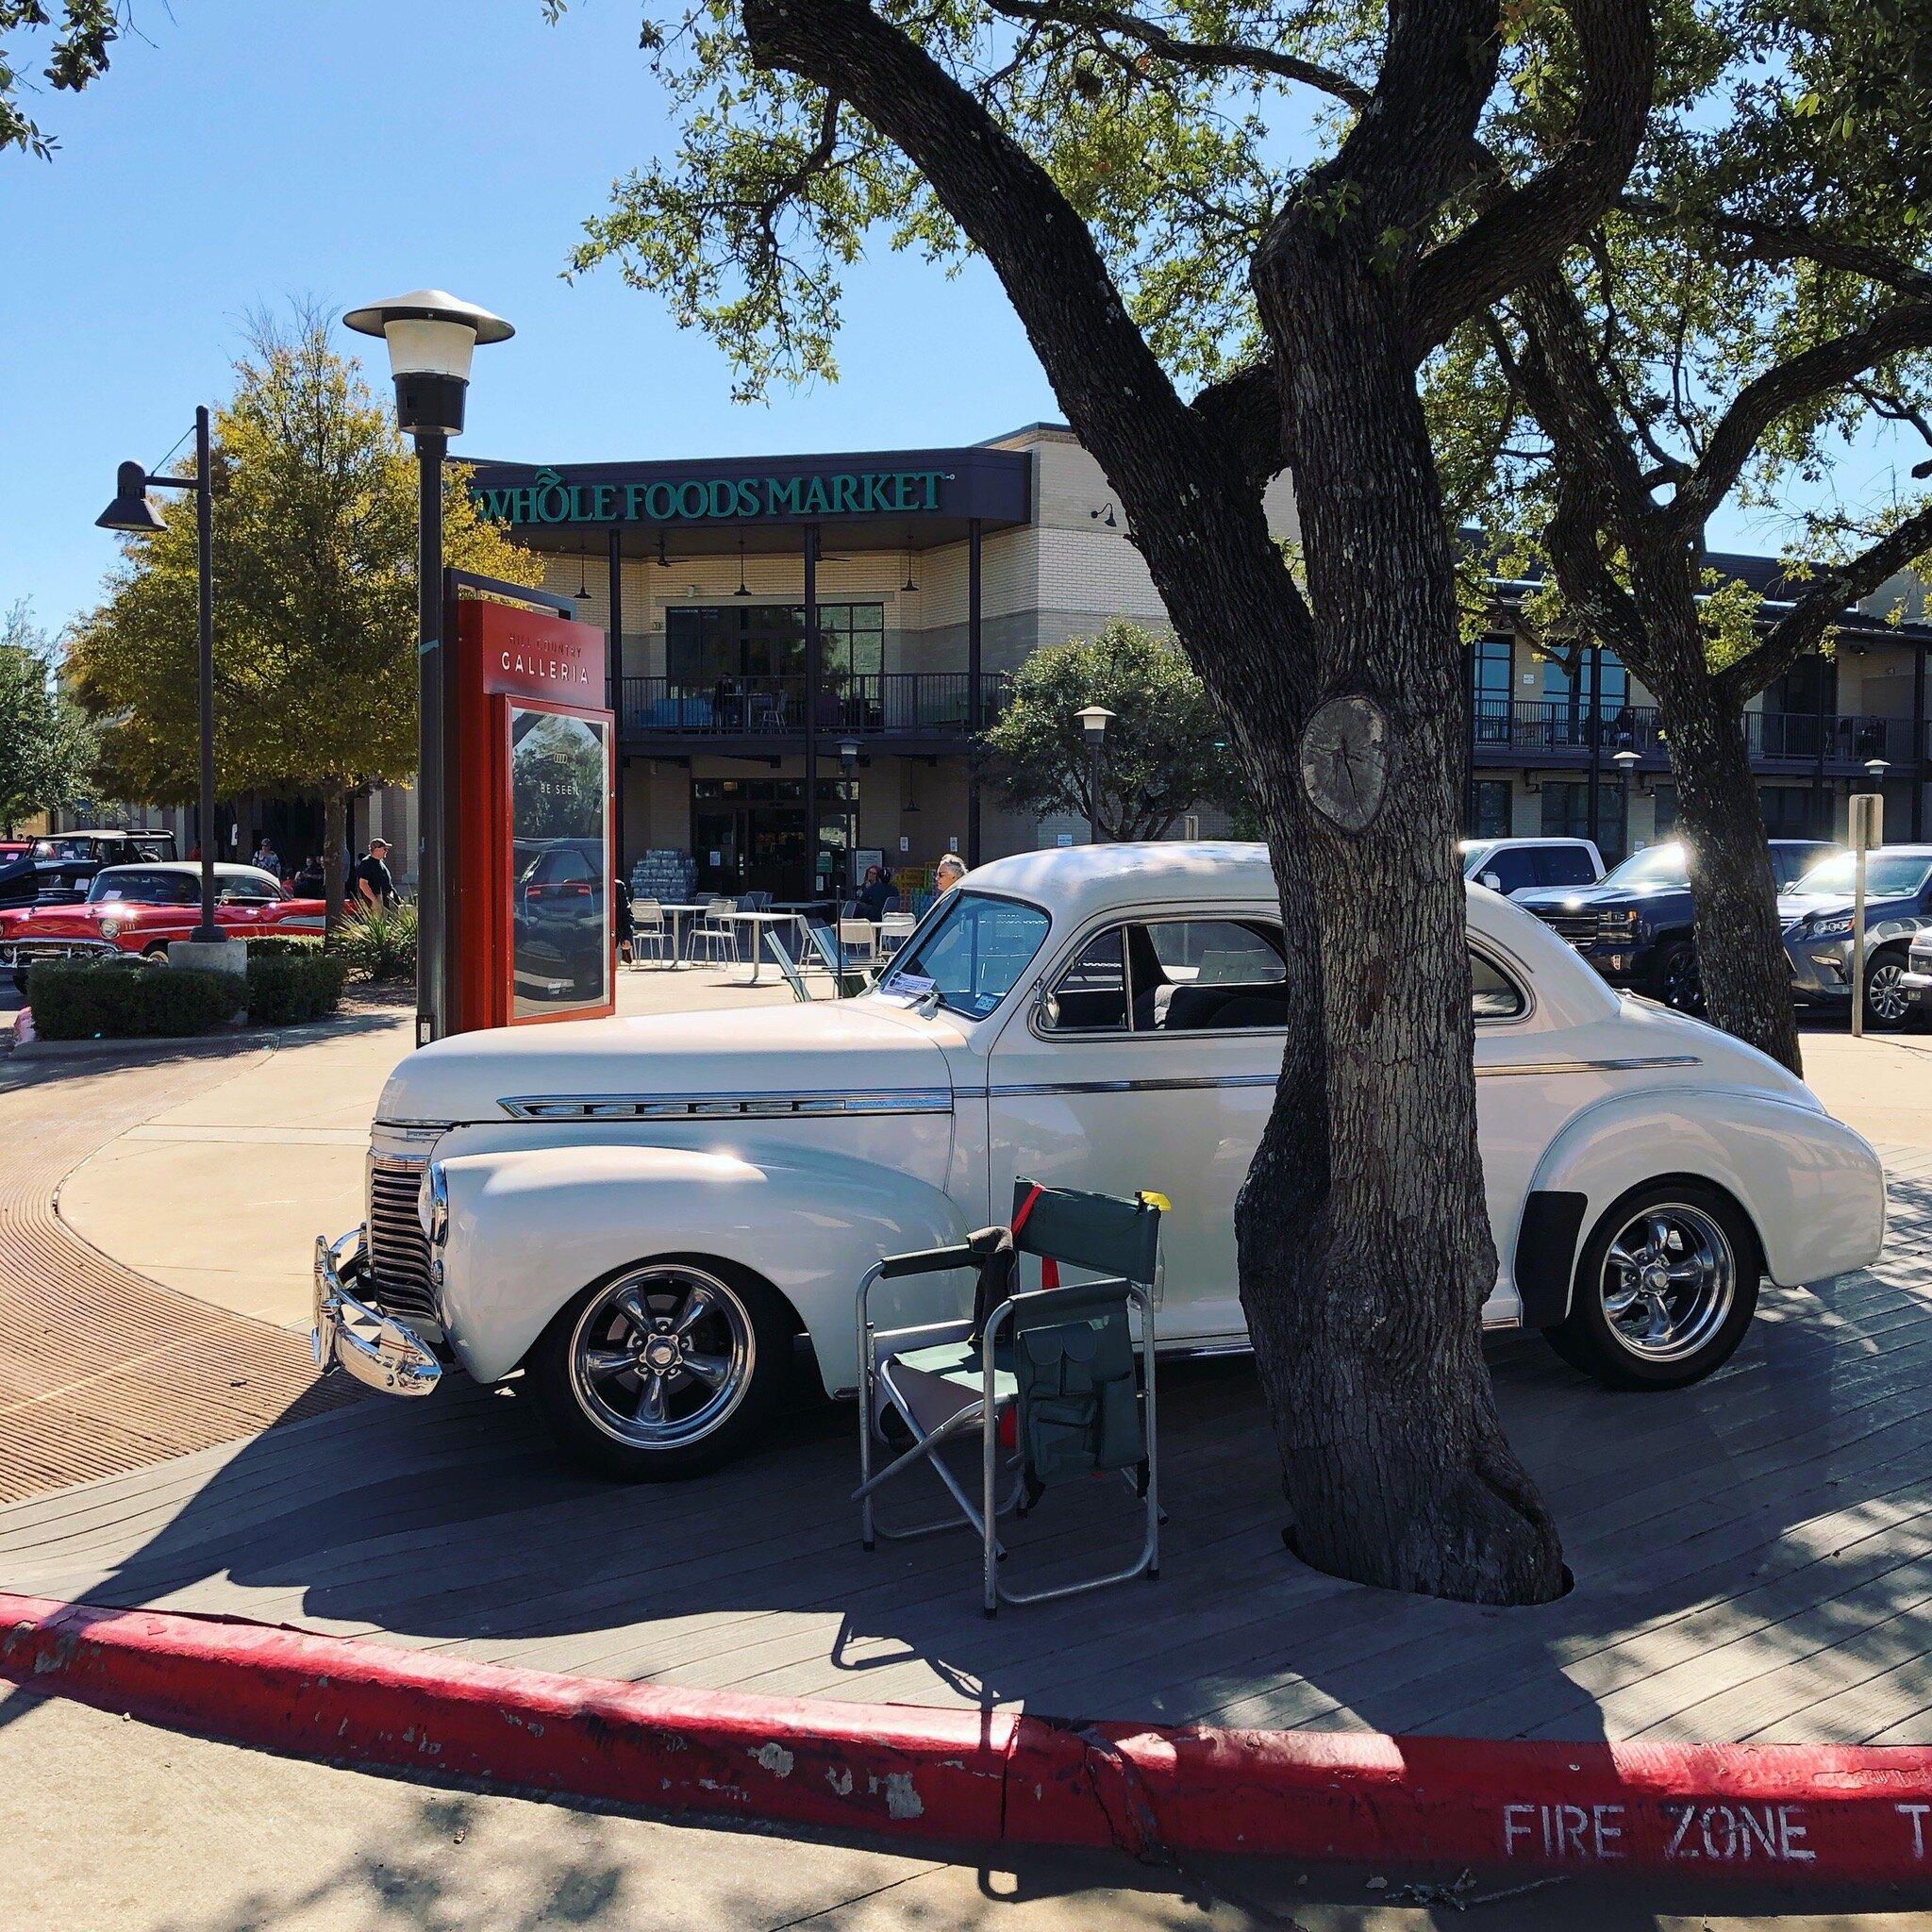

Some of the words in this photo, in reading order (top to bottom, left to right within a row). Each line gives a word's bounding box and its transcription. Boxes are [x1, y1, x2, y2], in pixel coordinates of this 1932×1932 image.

[472, 468, 616, 524] WHOLE
[625, 480, 760, 522] FOODS
[767, 471, 947, 515] MARKET
[536, 639, 582, 658] COUNTRY
[501, 651, 589, 685] GALLERIA
[541, 783, 551, 794] BE
[1505, 1804, 1625, 1858] FIRE
[1665, 1804, 1816, 1860] ZONE
